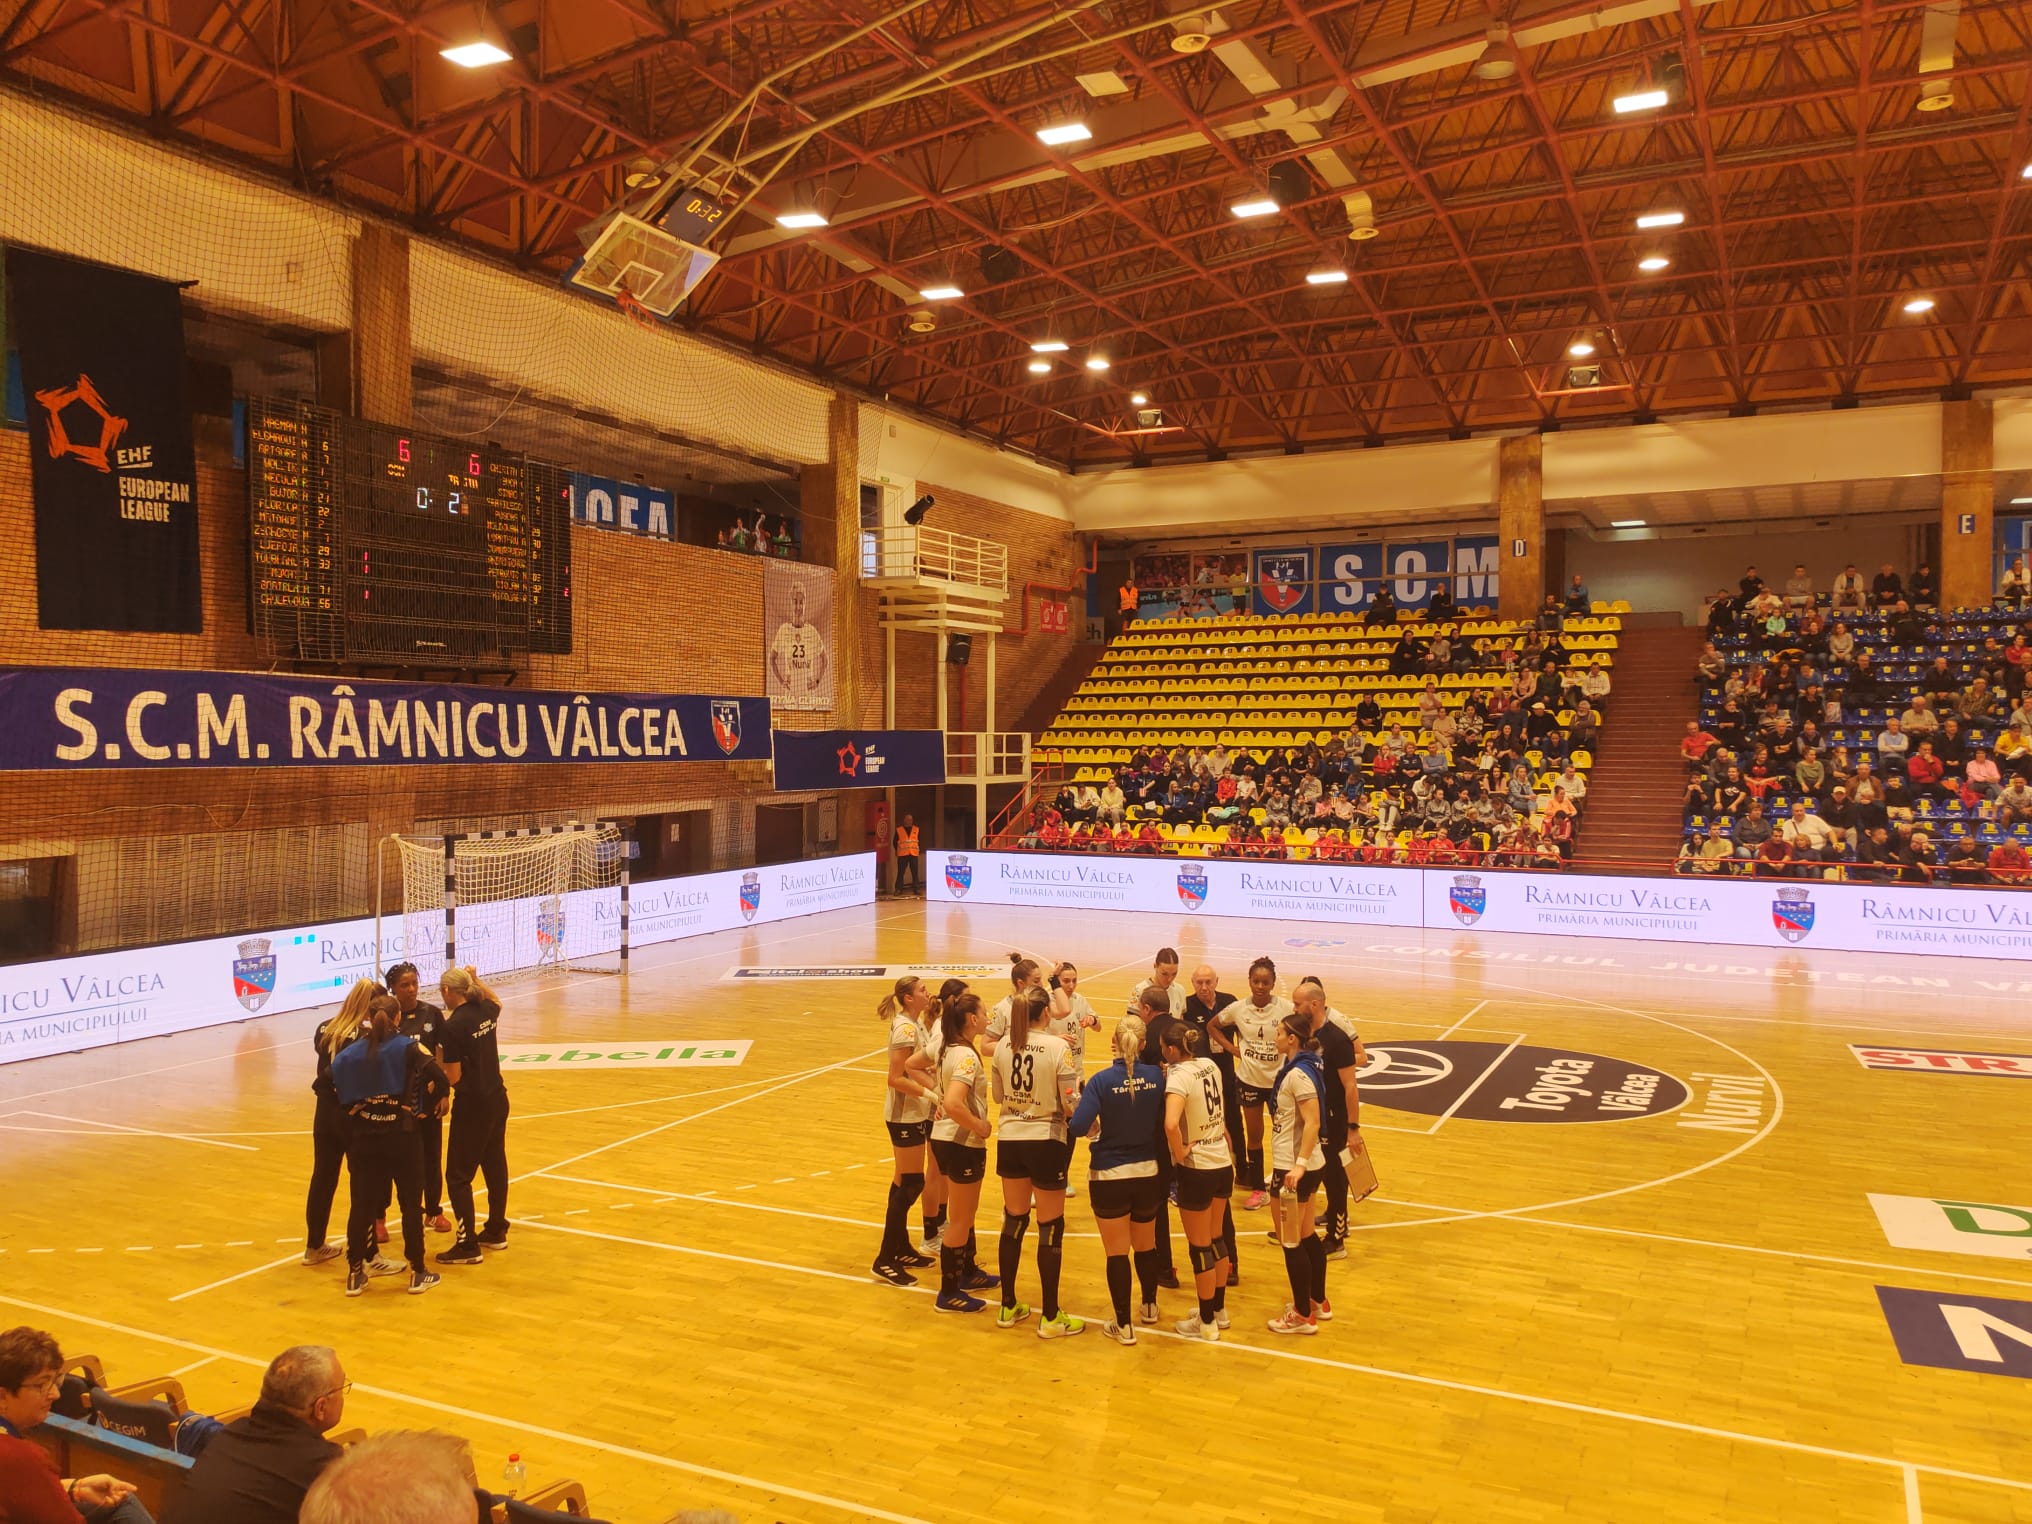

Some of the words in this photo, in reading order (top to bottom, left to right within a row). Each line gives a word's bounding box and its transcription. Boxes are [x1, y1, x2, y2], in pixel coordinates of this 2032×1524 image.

[116, 446, 153, 469] EHF
[399, 439, 411, 462] 6
[469, 453, 481, 475] 6
[119, 476, 190, 503] EUROPEAN
[120, 498, 170, 522] LEAGUE
[1961, 514, 1972, 534] E
[1515, 539, 1525, 556] D
[792, 644, 806, 658] 23
[54, 687, 270, 761] S.C.M.
[289, 684, 528, 759] RÂMNICU
[538, 694, 688, 758] VÂLCEA
[780, 869, 828, 892] RÂMNICU
[830, 866, 865, 884] VÂLCEA
[1000, 863, 1071, 882] RÂMNICU
[1076, 866, 1134, 885] VÂLCEA
[1240, 873, 1323, 894] RÂMNICU
[1329, 876, 1397, 897] VÂLCEA
[663, 890, 710, 910] VÂLCEA
[1306, 902, 1386, 914] MUNICIPIULUI
[1526, 885, 1623, 909] RÂMNICU
[1631, 889, 1712, 912] VÂLCEA
[1538, 912, 1599, 926] PRIMĂRIA
[1603, 917, 1698, 931] MUNICIPIULUI
[1862, 899, 1976, 924] RÂMNICU
[1876, 929, 1948, 944] PRIMĂRIA
[1365, 943, 1625, 968] CONSILIUL
[60, 973, 165, 1004] VÂLCEA
[22, 1008, 147, 1042] MUNICIPIULUI
[1257, 1025, 1264, 1040] 4
[498, 1047, 738, 1064] abella
[1010, 1052, 1034, 1093] 83
[1203, 1073, 1222, 1116] 64
[1499, 1058, 1595, 1112] Toyota
[1598, 1072, 1661, 1112] Vâlcea
[1675, 1071, 1766, 1134] Nurvil
[110, 1421, 146, 1437] CEGIM
